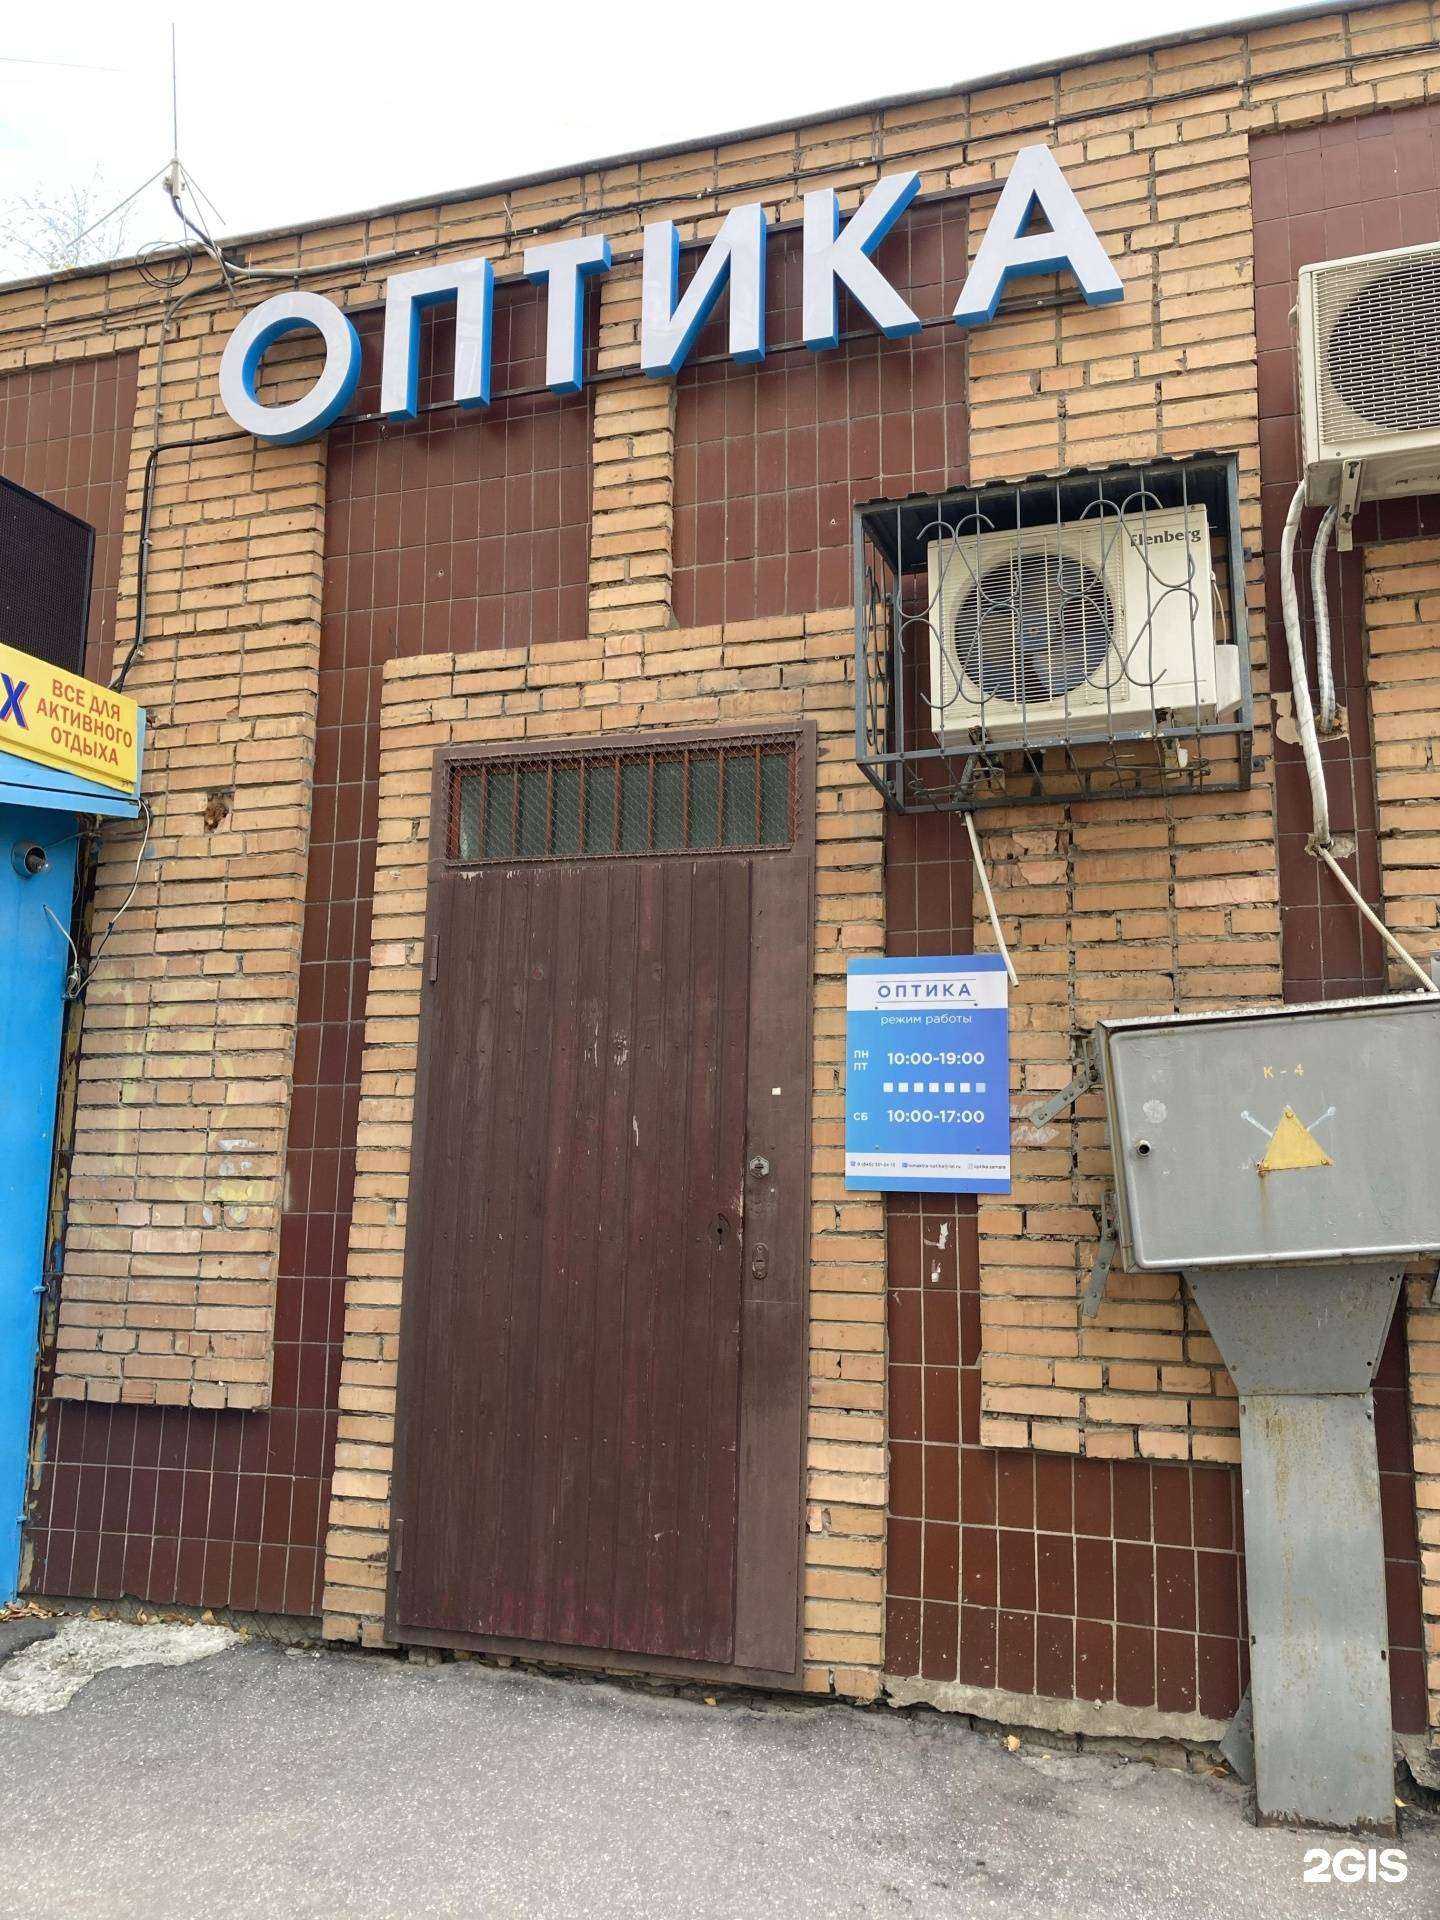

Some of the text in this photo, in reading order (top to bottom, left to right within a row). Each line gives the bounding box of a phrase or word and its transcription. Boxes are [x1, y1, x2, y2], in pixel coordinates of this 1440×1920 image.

[219, 144, 1123, 444] ОПТИКА
[52, 678, 121, 722] ВСЕ ДЛЯ
[36, 697, 133, 748] АКТИВНОГО
[50, 726, 119, 766] ОТДЫХА
[877, 983, 972, 998] ОПТИКА
[880, 1013, 972, 1025] режим работы
[854, 1050, 869, 1059] ПН
[887, 1052, 985, 1065] 10:00-19:00
[853, 1062, 868, 1071] ПТ
[853, 1111, 868, 1121] СБ
[887, 1110, 985, 1123] 10:00-17:00
